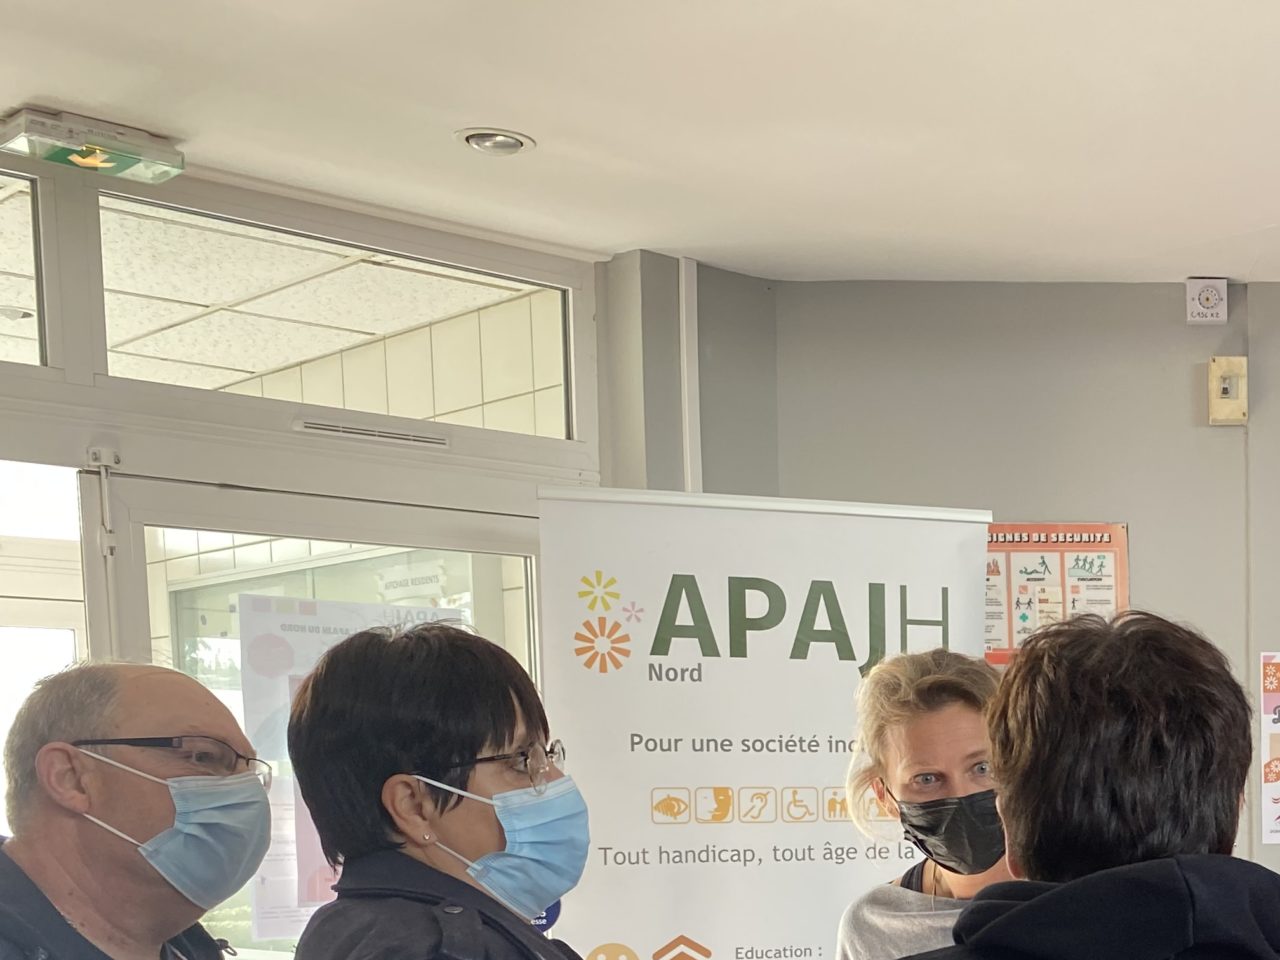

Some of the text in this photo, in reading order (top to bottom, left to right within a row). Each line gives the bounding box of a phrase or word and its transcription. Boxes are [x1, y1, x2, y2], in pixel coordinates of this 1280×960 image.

[1033, 533, 1048, 543] DE
[649, 574, 949, 678] APAJH
[648, 663, 702, 682] Nord
[630, 733, 682, 752] Pour
[692, 737, 733, 752] une
[741, 735, 820, 753] société
[598, 842, 915, 867] Tout handicap, tout âge de la
[735, 945, 812, 960] Education
